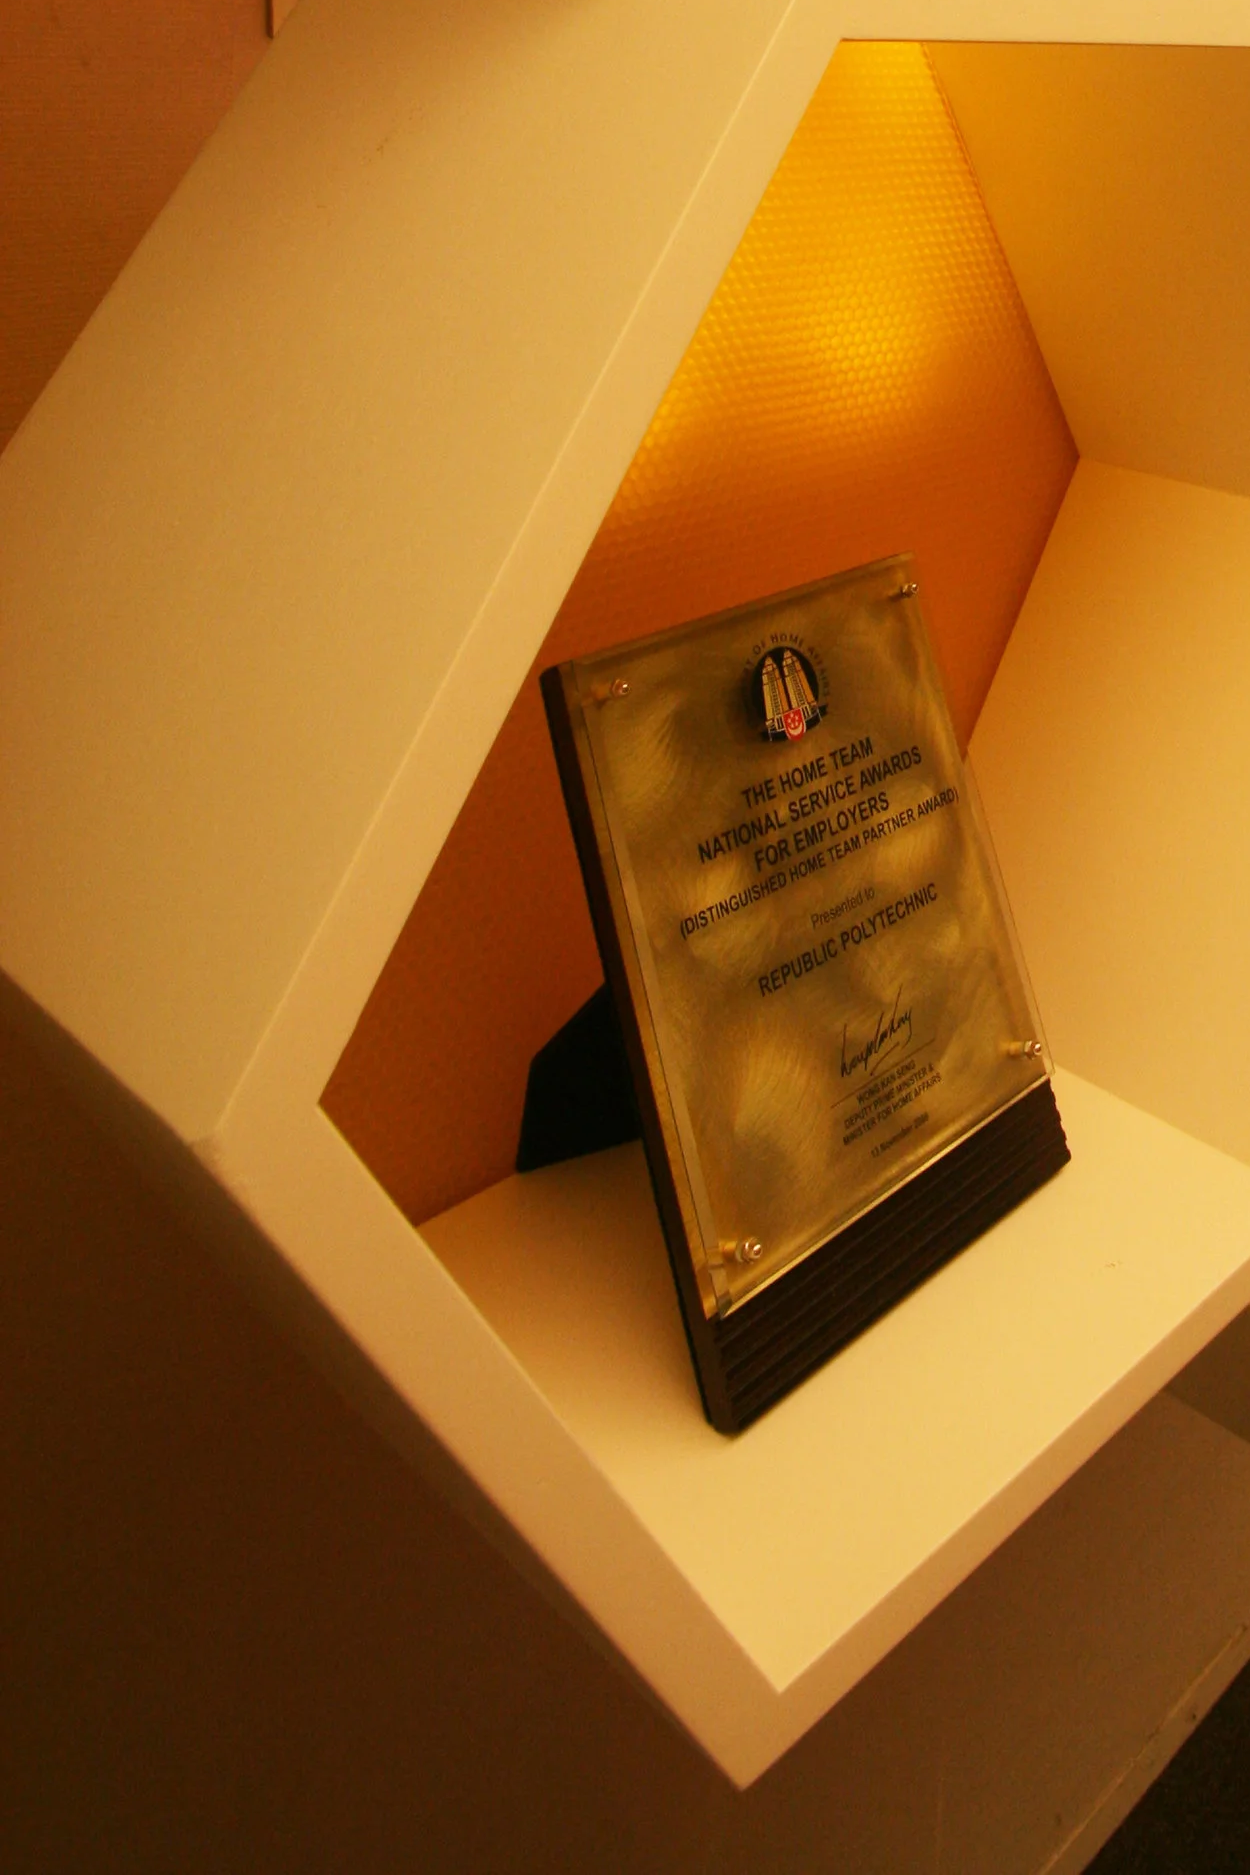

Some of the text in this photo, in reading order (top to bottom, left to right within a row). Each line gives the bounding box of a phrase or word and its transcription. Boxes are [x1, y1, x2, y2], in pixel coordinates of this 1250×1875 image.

[697, 745, 922, 865] NATIONAL SERVICE AWARDS
[741, 737, 874, 810] THE HOME TEAM
[680, 786, 960, 940] (DISTINGUISHED HOME TEAM PARTNER AWARD)
[753, 792, 890, 872] FOR EMPLOYERS
[758, 883, 938, 998] REPUBLIC POLYTECHNIC
[810, 886, 875, 929] Presented to
